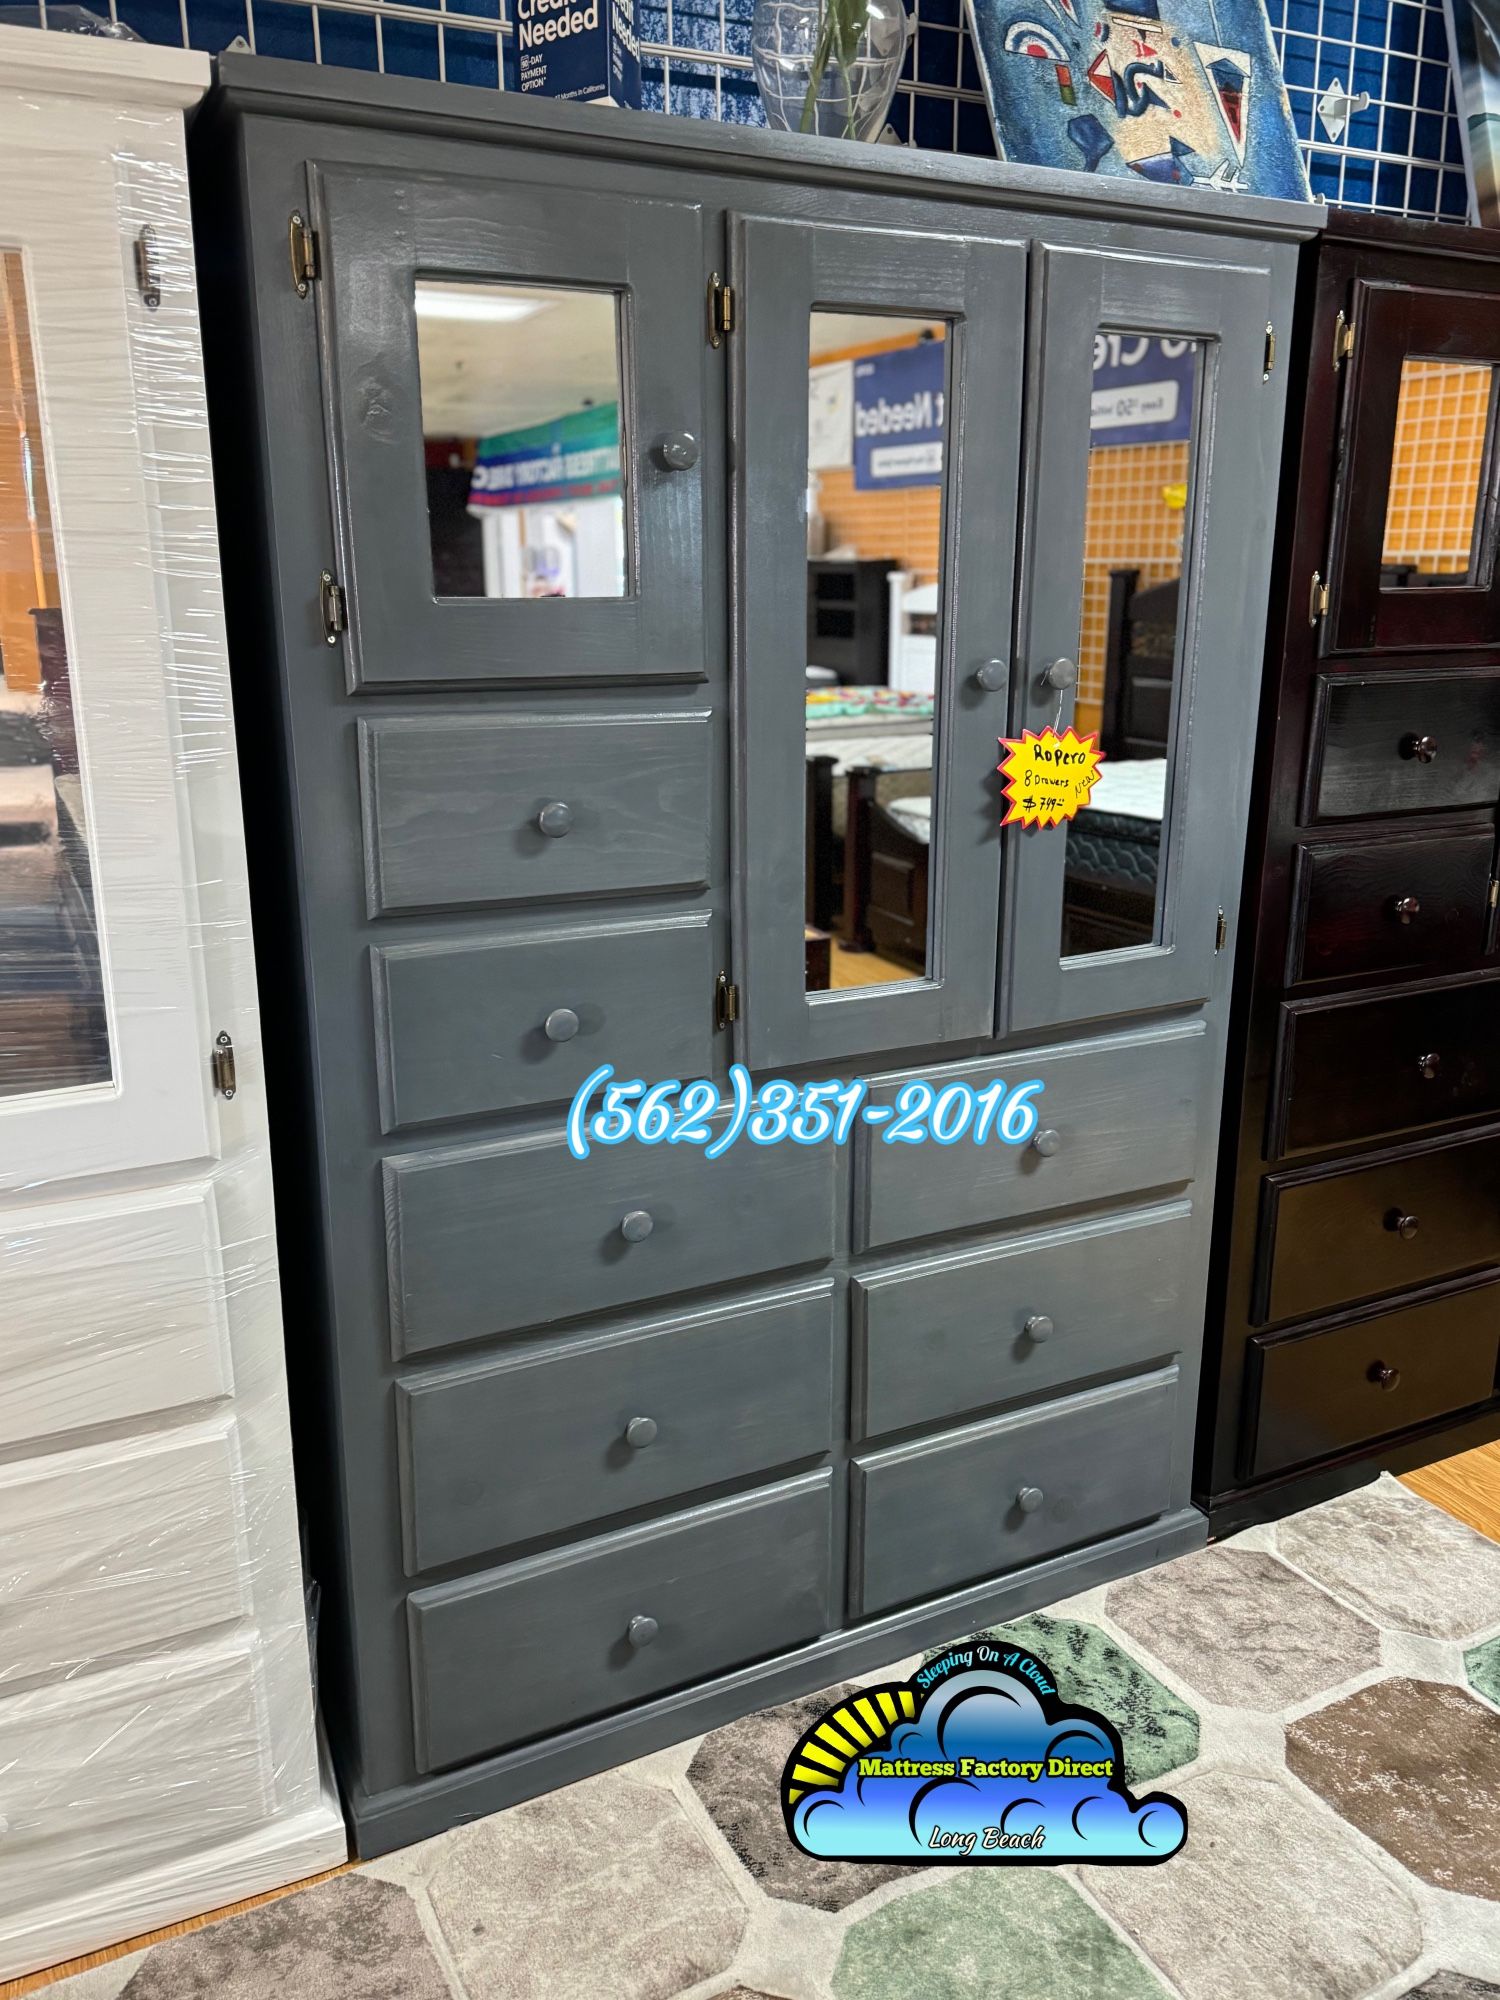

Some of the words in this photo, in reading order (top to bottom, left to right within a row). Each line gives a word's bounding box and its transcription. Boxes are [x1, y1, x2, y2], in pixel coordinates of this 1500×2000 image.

[518, 0, 599, 51] Needed
[521, 65, 547, 81] PAYMENT
[1024, 769, 1032, 786] 8
[1034, 774, 1069, 788] Drawers
